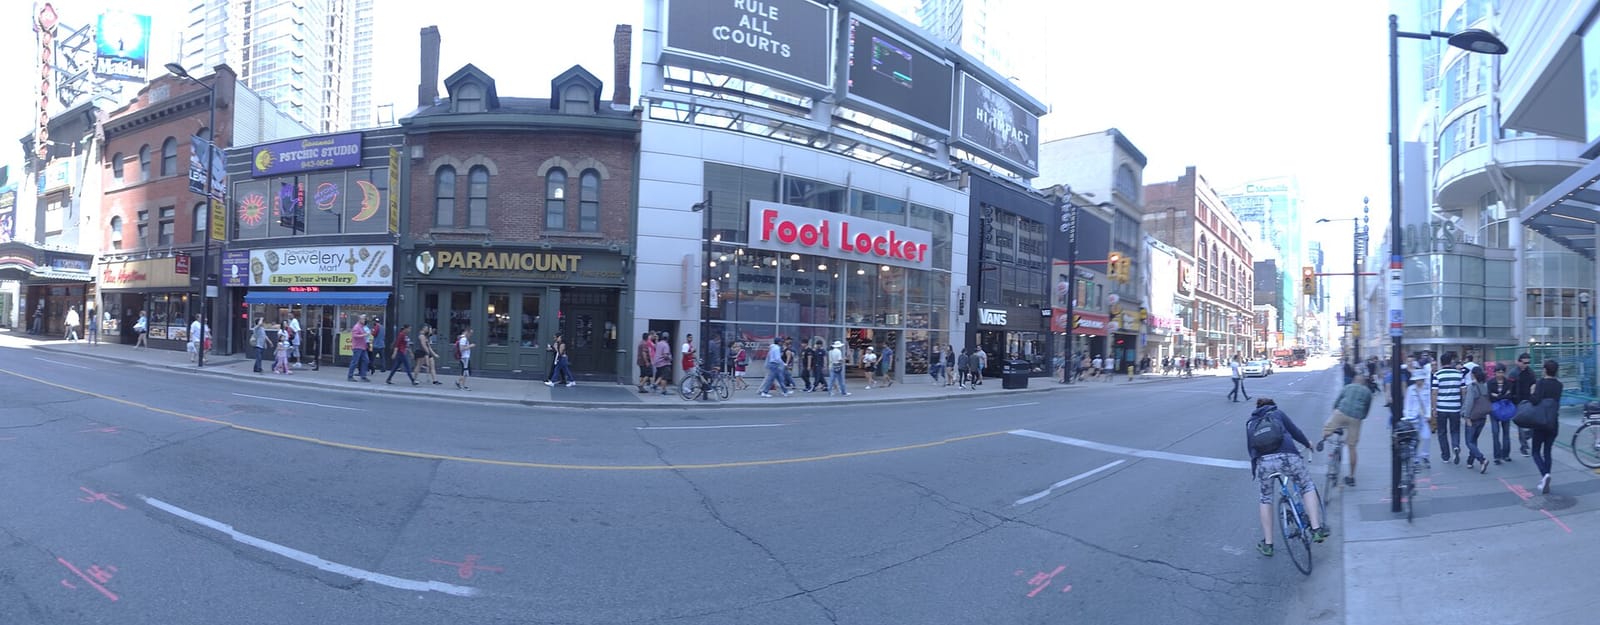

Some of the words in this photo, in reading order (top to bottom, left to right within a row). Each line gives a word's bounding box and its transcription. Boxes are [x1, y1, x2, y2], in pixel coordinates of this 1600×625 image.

[734, 0, 779, 20] RULE
[739, 14, 773, 36] ALL
[279, 148, 319, 162] PSYCHIC
[320, 144, 359, 158] STUDIO
[760, 209, 830, 249] Foot
[840, 221, 929, 263] Locker
[280, 250, 345, 267] Jewelery
[437, 251, 582, 272] PARAMOUNT
[318, 265, 337, 273] Mart
[279, 276, 294, 284] Buy
[294, 275, 314, 283] Your
[314, 275, 353, 284] Jwellery
[978, 307, 1008, 326] VANS
